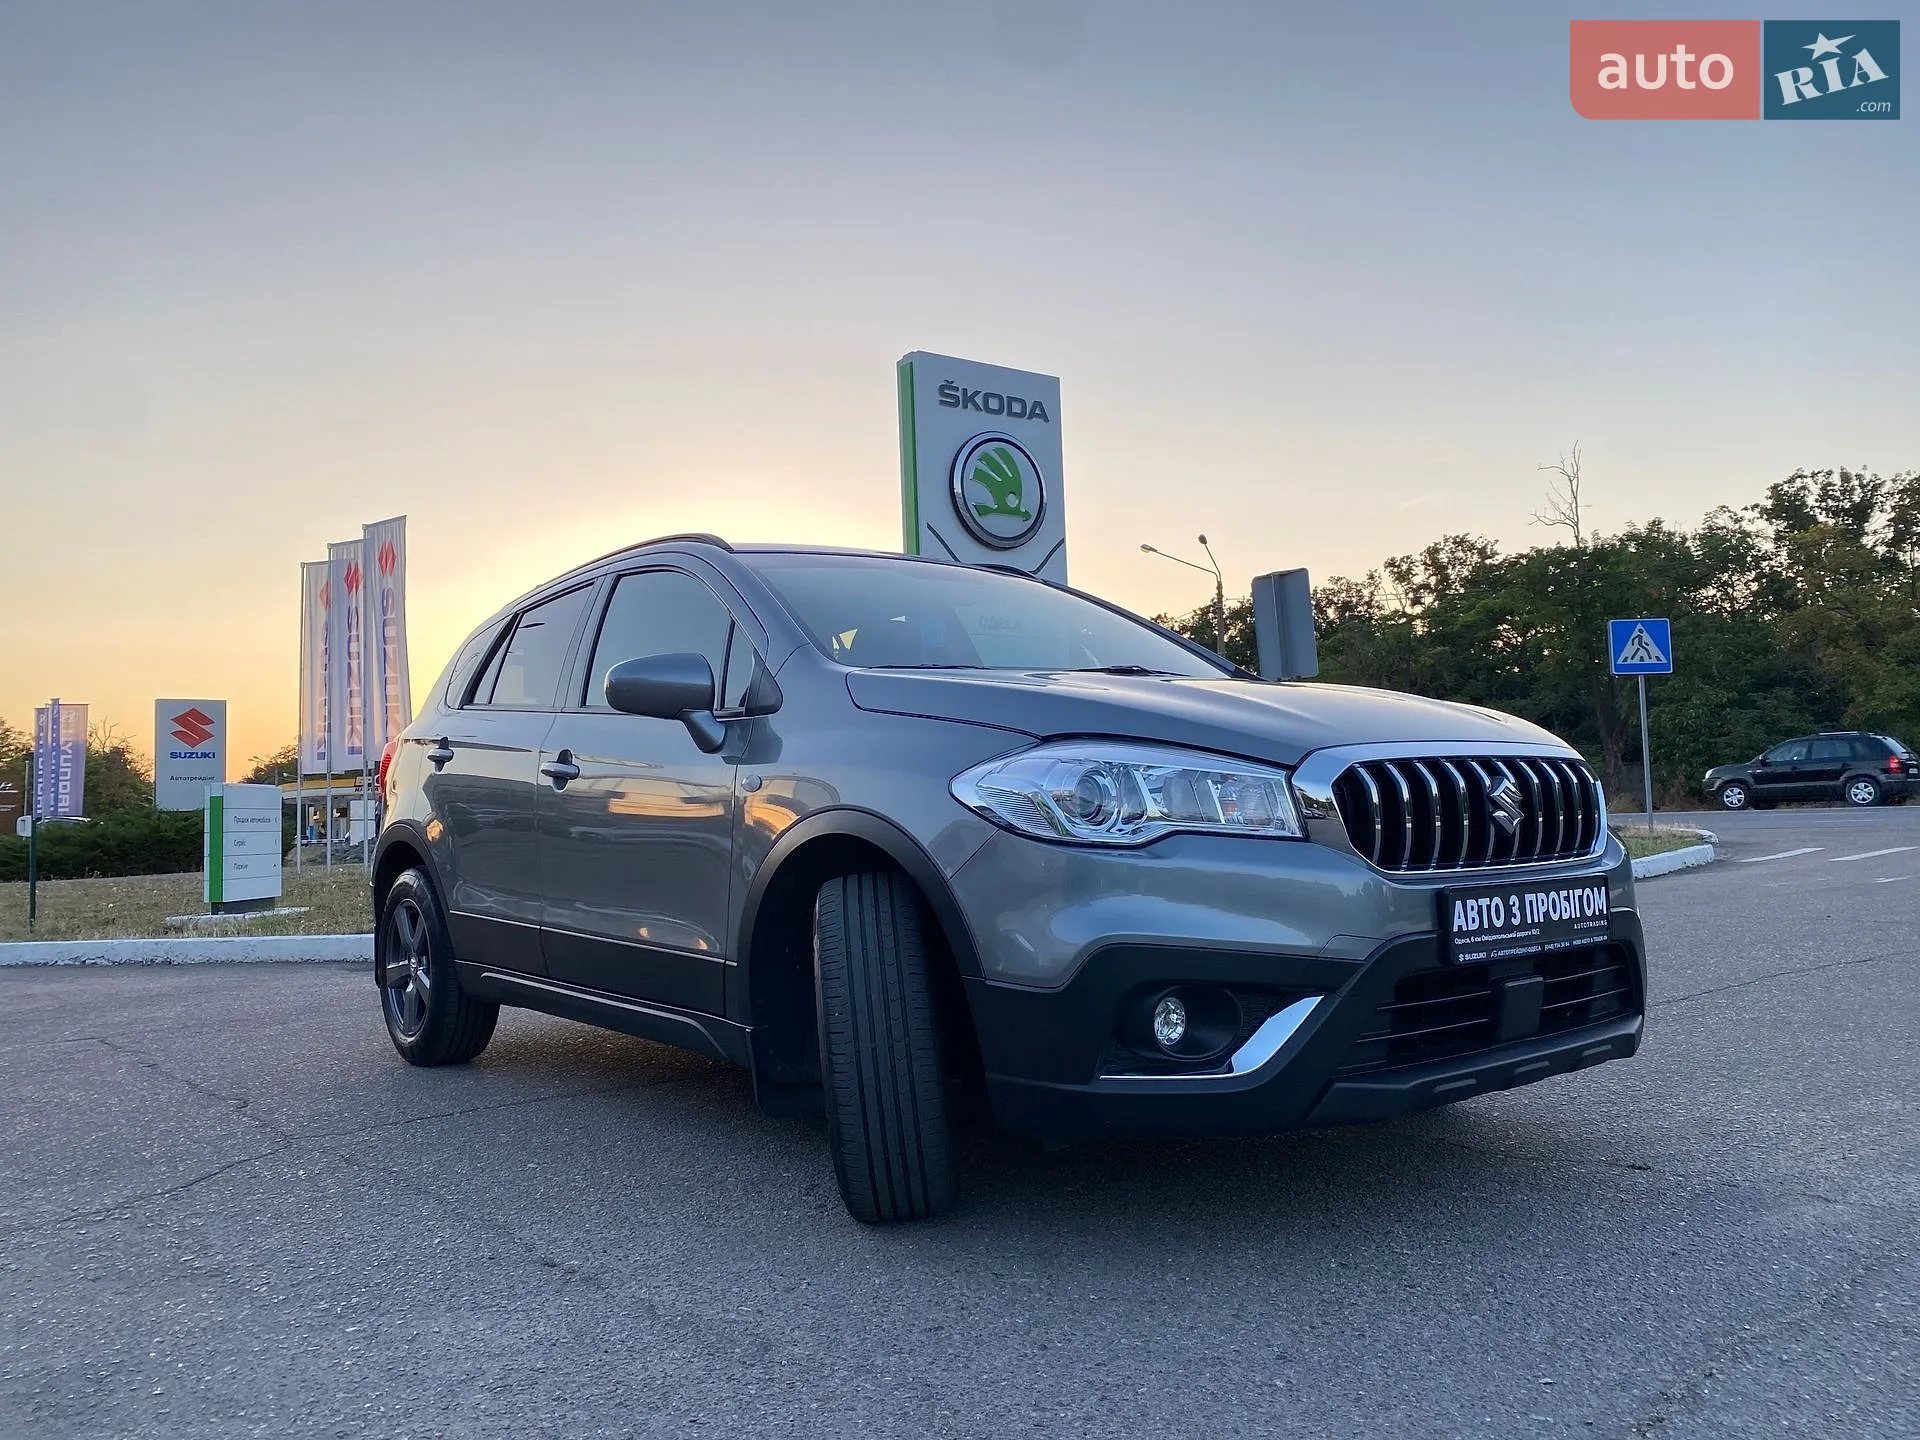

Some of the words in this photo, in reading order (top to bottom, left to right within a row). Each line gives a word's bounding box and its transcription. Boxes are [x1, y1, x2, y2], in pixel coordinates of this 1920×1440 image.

[938, 379, 1050, 424] ŠKODA
[347, 606, 364, 755] SUZUKI
[169, 751, 216, 759] SUZUKI
[1453, 896, 1505, 932] АВТО
[1524, 886, 1607, 924] ПРОБІГОМ
[1573, 919, 1608, 930] AUTOTRADING
